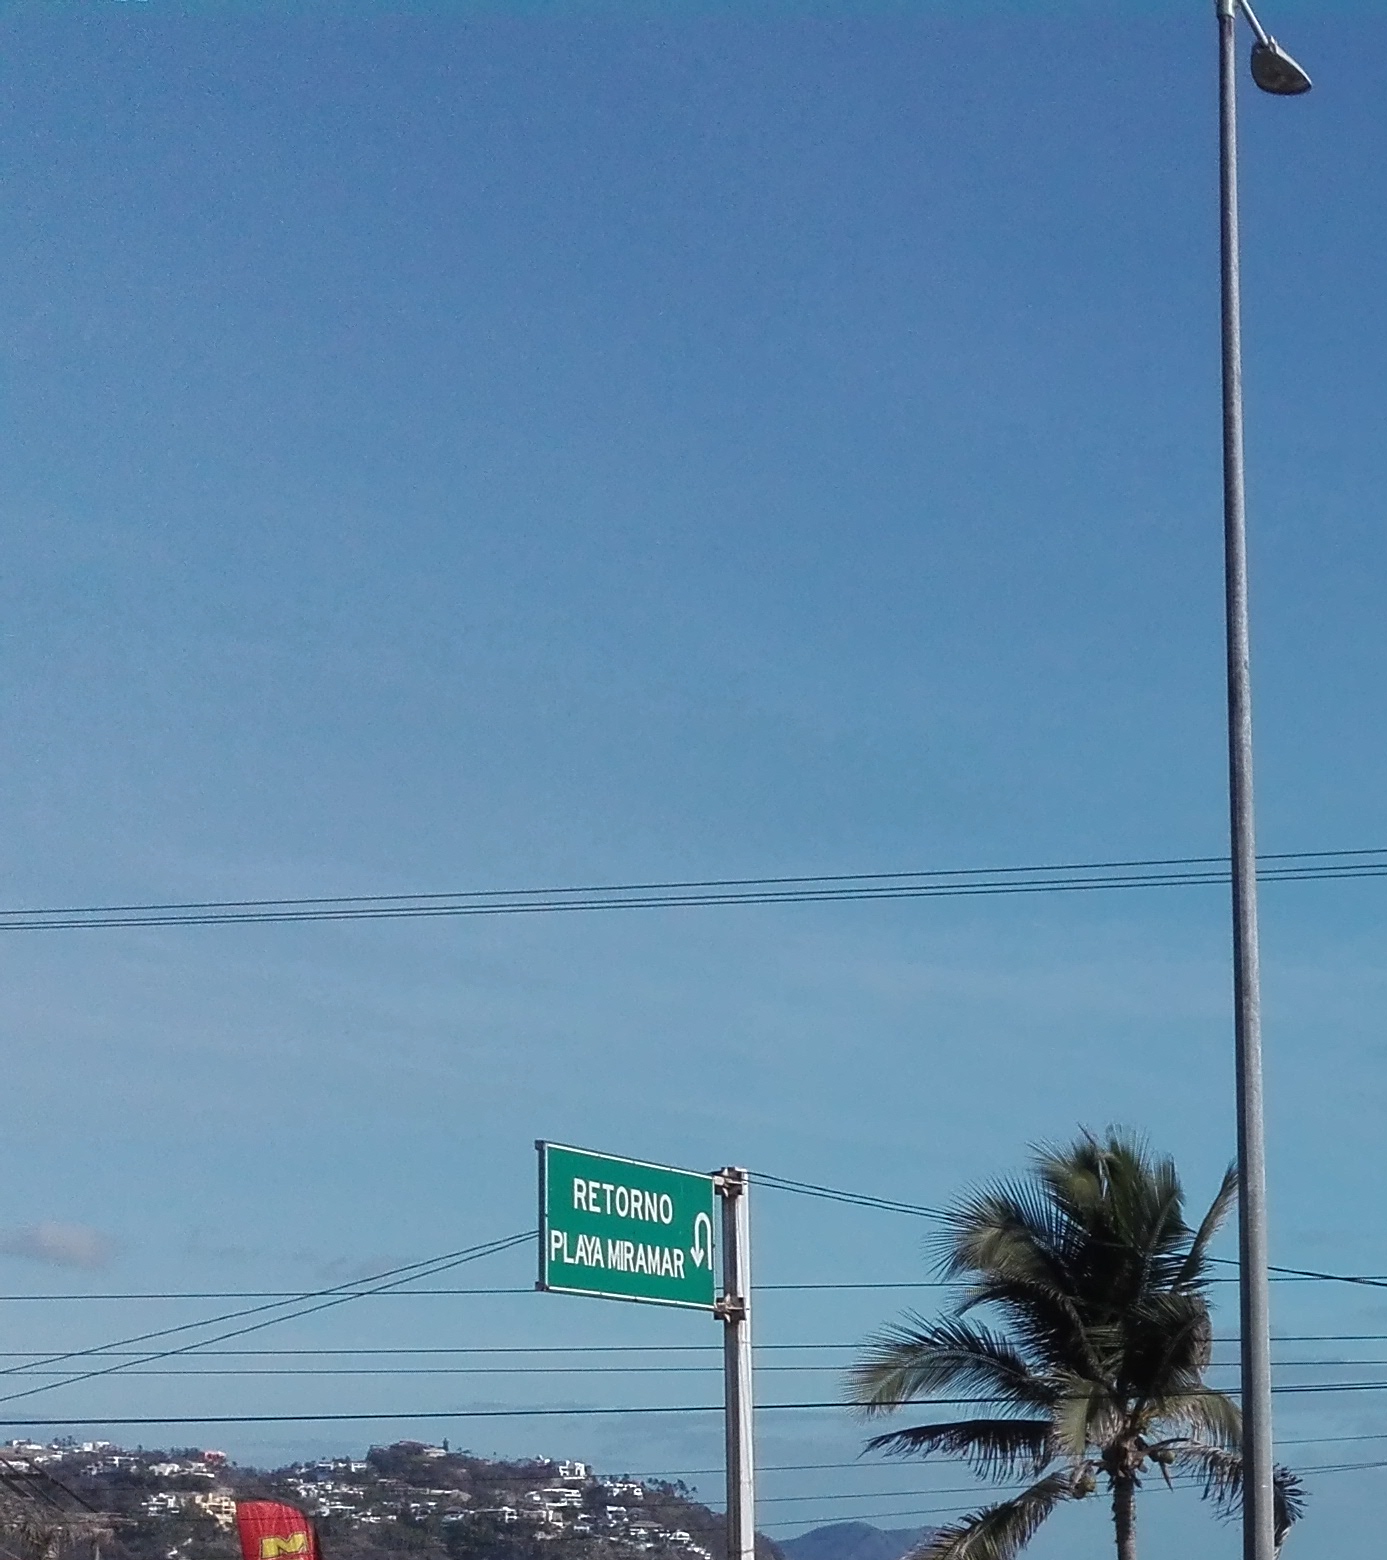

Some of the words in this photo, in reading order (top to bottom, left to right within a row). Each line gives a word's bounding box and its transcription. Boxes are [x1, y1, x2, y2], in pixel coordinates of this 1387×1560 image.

[573, 1177, 673, 1225] RETORNO
[551, 1229, 605, 1269] PLAYA
[607, 1238, 685, 1279] MIRAMAR
